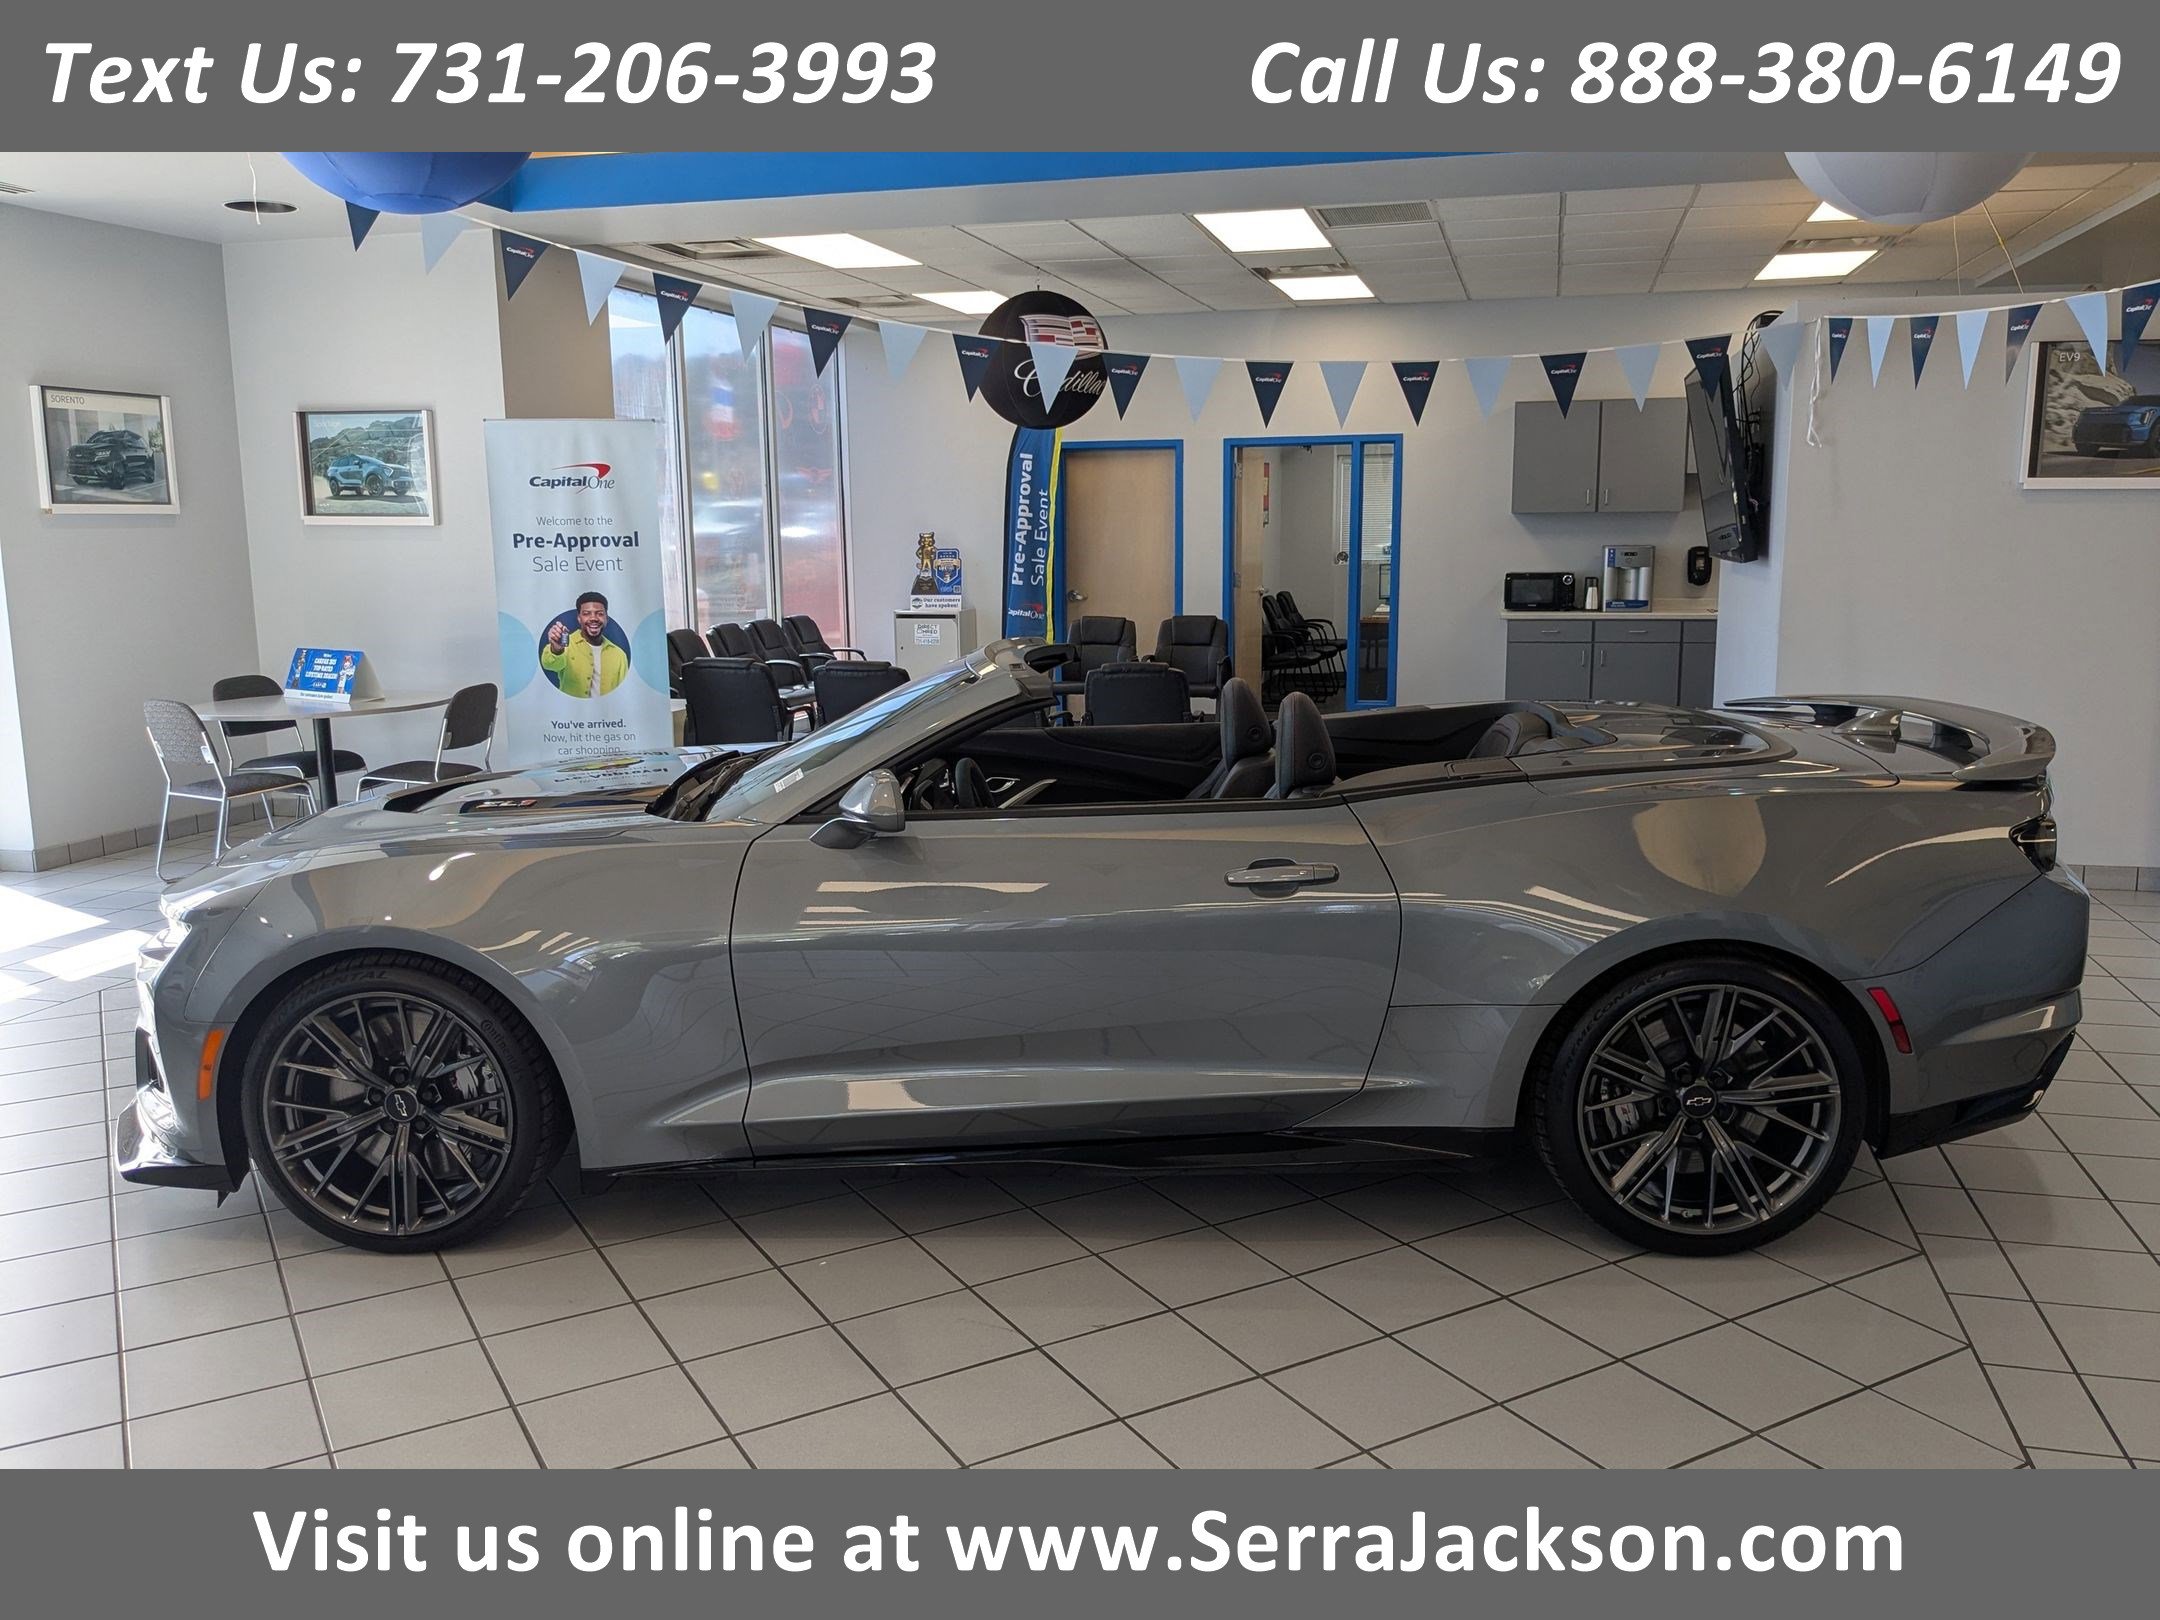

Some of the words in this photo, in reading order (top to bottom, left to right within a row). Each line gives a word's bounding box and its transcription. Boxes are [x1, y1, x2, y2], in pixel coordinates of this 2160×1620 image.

[2059, 352, 2081, 362] EV9
[1014, 358, 1105, 398] Cdilla
[50, 394, 85, 406] SORENTO
[536, 516, 582, 526] Welcome
[584, 517, 595, 526] to
[597, 516, 613, 526] the
[1011, 452, 1034, 586] Pre-Approval
[1034, 488, 1049, 542] Event
[512, 531, 640, 552] Pre-Approval
[532, 556, 569, 573] Sale
[575, 556, 624, 572] Event
[1030, 547, 1046, 587] Sale
[551, 720, 585, 730] You've
[587, 718, 627, 729] arrived.
[543, 733, 568, 744] Now,
[570, 732, 583, 742] hit
[585, 732, 601, 742] the
[603, 733, 621, 744] gas
[623, 732, 636, 741] on
[558, 747, 574, 756] car
